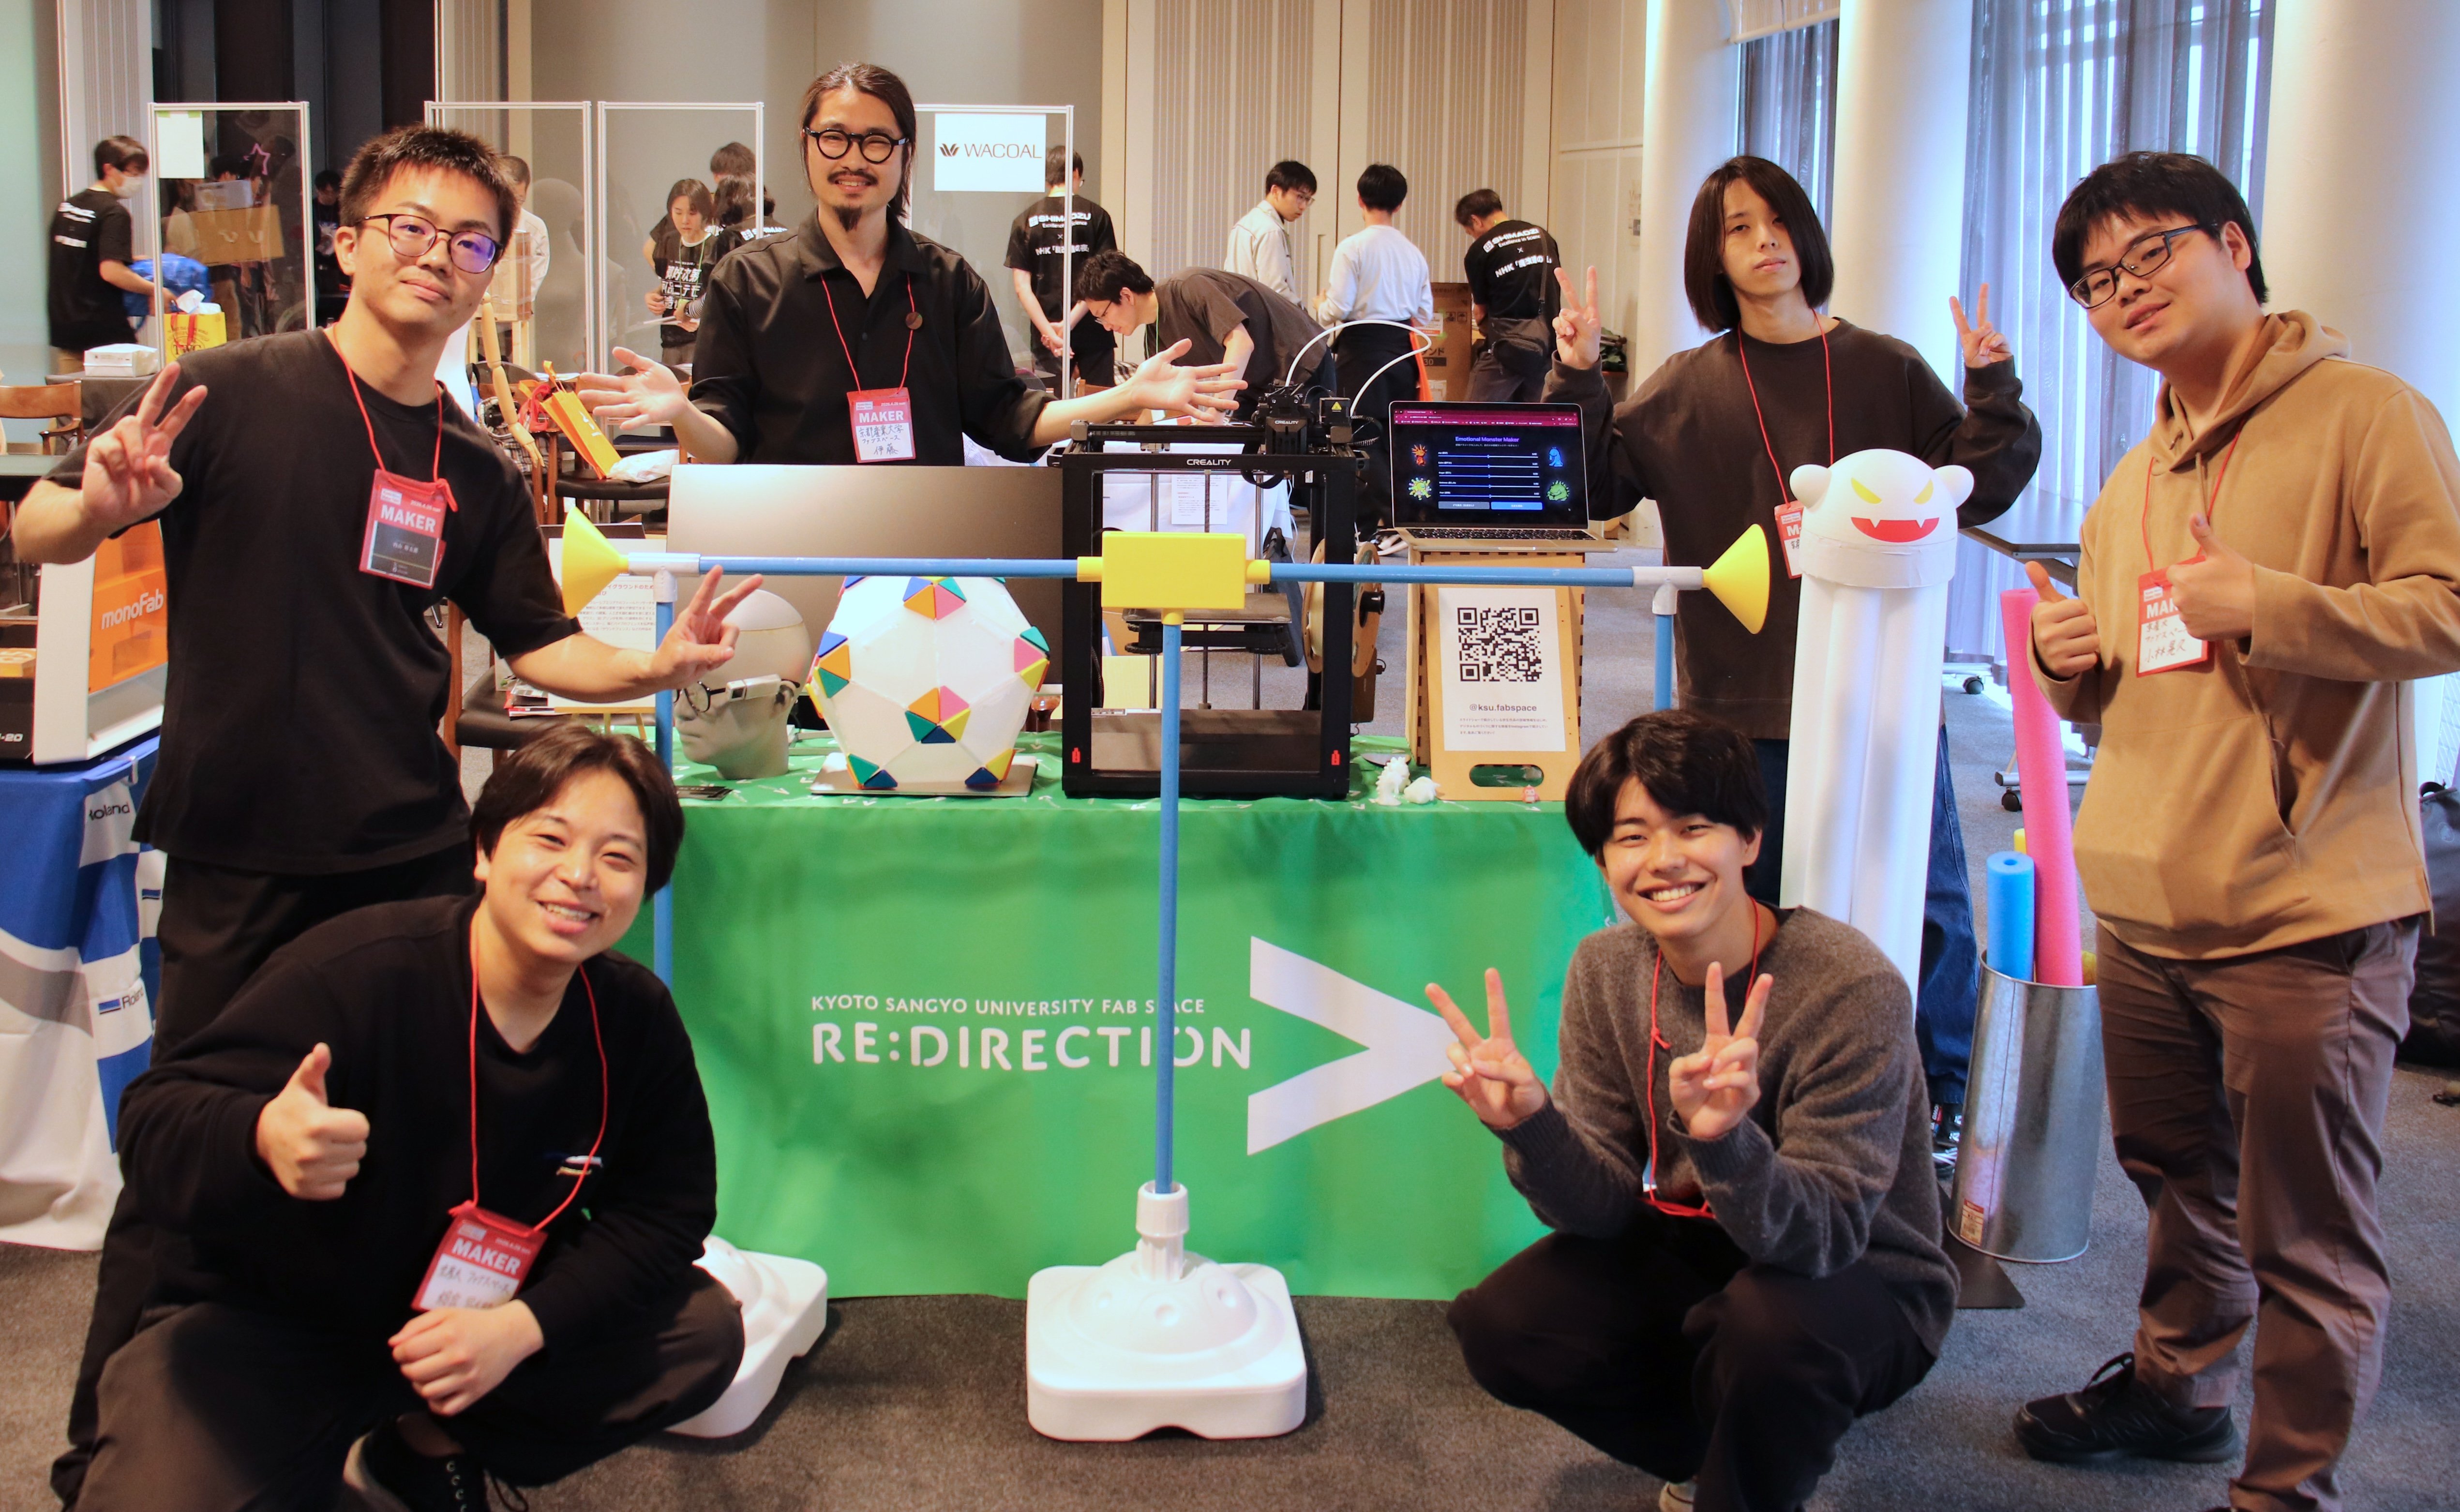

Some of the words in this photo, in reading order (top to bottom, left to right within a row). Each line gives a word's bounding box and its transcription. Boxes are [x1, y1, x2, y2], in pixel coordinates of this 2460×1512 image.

[963, 143, 1042, 159] WACOAL
[1038, 212, 1092, 223] SHIMDZU
[1035, 247, 1051, 255] NHK
[1495, 263, 1515, 278] NHK
[859, 410, 904, 423] MAKER
[380, 504, 437, 534] MAKER
[101, 588, 165, 630] monoFab
[2146, 598, 2179, 619] MAK
[1470, 704, 1537, 713] @ksu.fabspace
[0, 733, 23, 742] -20
[811, 995, 878, 1011] KYOTO
[885, 997, 967, 1014] SANGYO
[975, 998, 1094, 1017] UNIVERSITY
[1102, 999, 1137, 1014] FAB
[1145, 999, 1205, 1014] SCE
[811, 1021, 1250, 1071] RE:DIRECTION
[451, 1238, 522, 1275] MAKER
